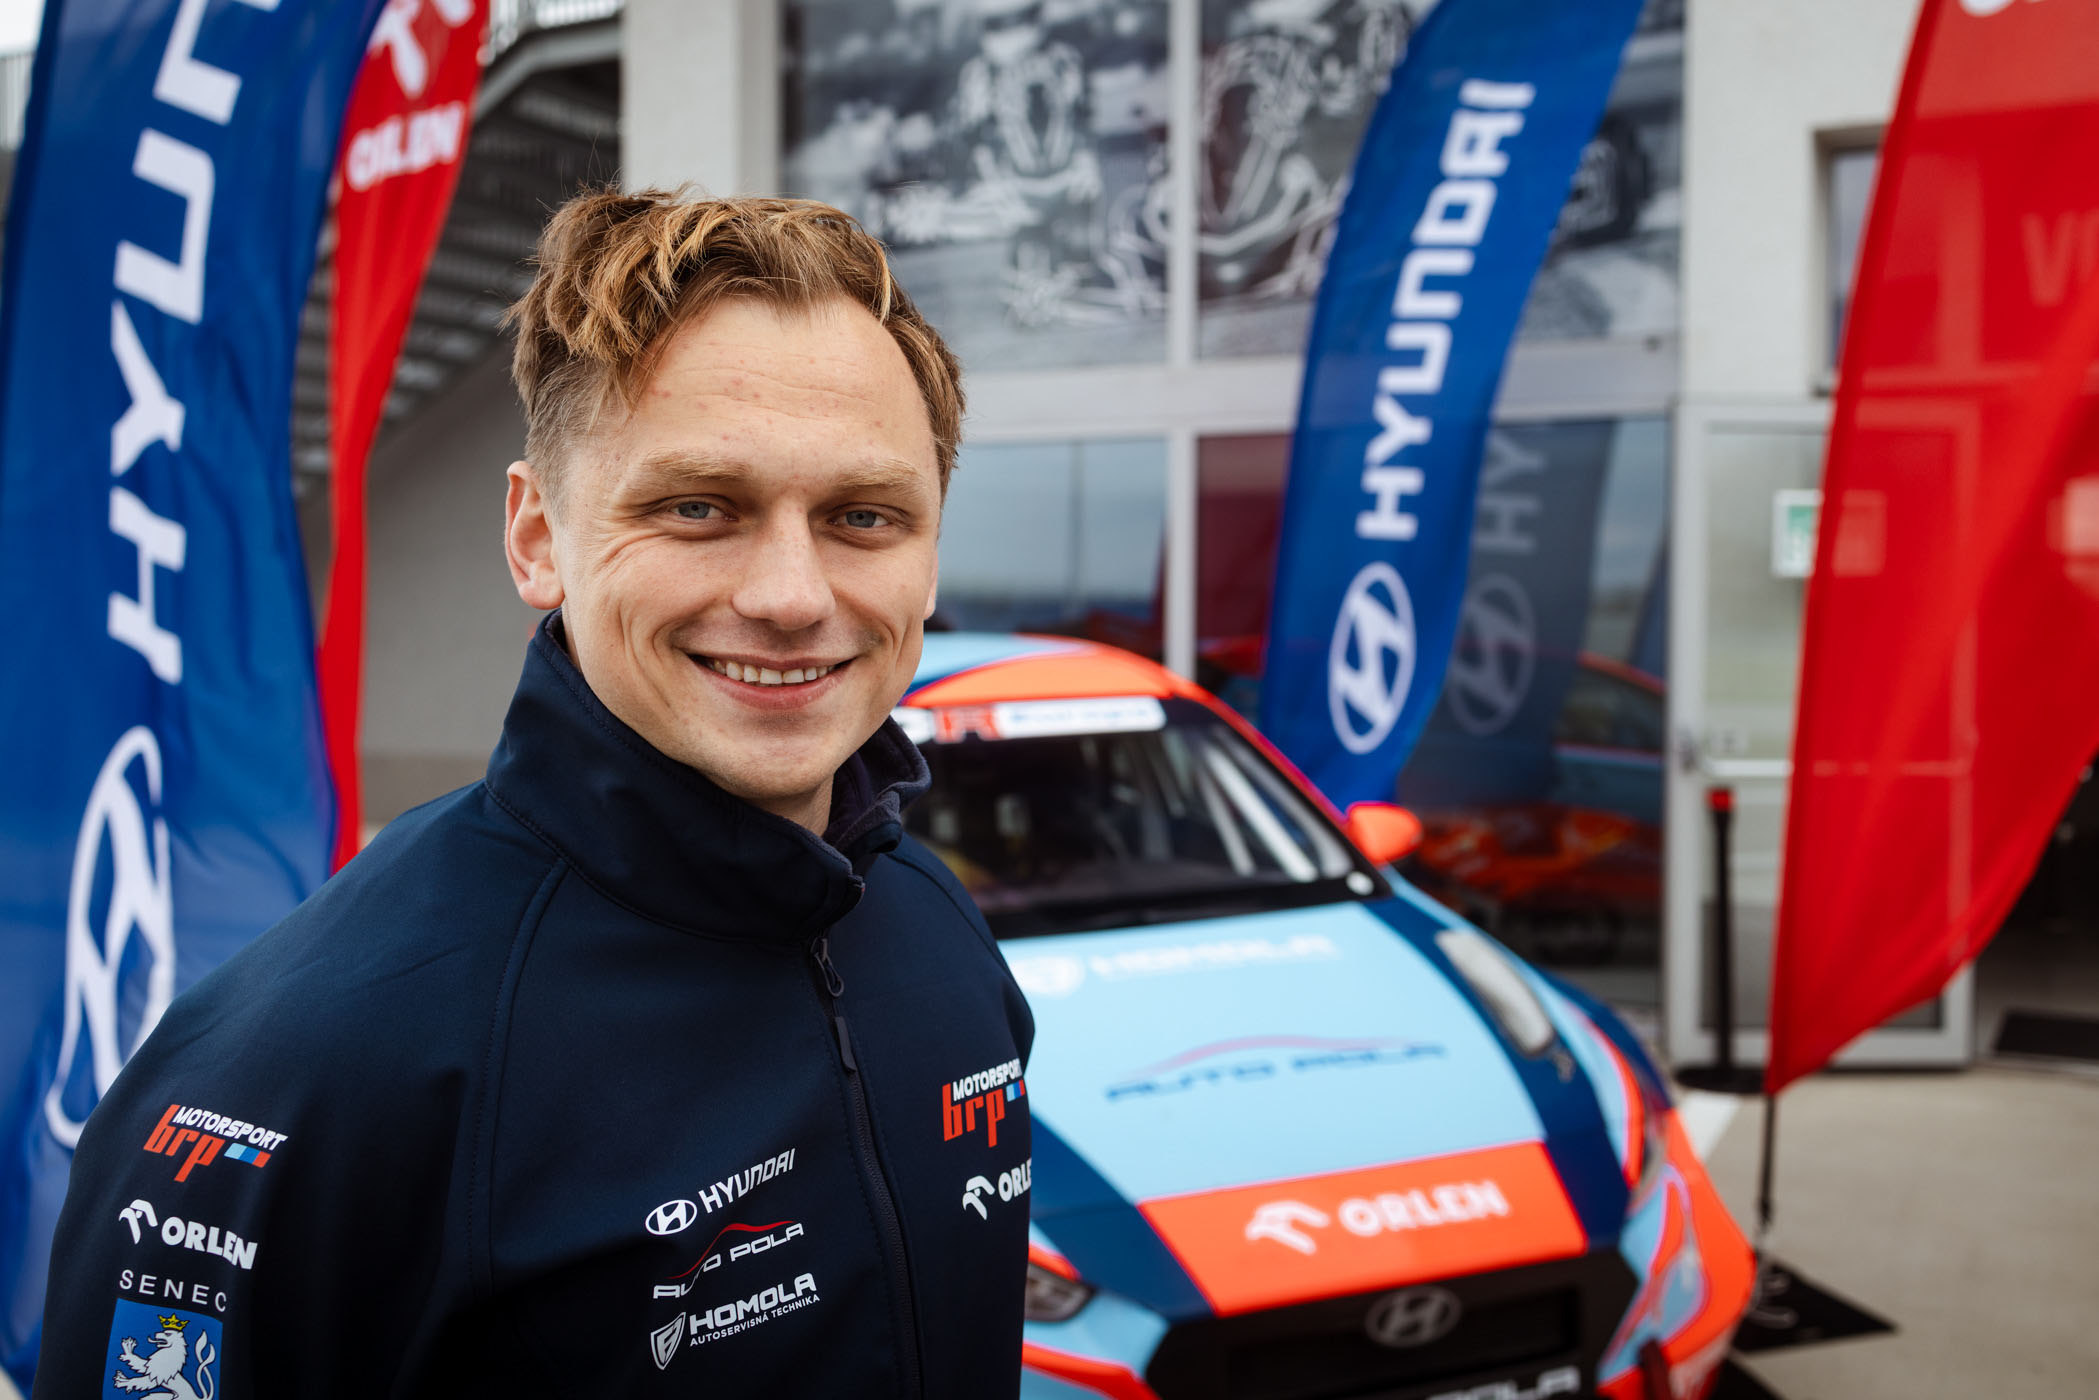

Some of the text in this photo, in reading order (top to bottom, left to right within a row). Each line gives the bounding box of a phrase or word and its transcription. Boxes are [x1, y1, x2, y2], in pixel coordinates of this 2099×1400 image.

[1354, 78, 1537, 542] HYUNDAI
[952, 1058, 1023, 1101] MOTORSPOR
[172, 1106, 289, 1150] MOTORSPORT
[942, 1083, 1006, 1148] brp
[143, 1104, 226, 1183] brp
[698, 1148, 796, 1214] HYUNDAI
[998, 1157, 1032, 1202] ORLE
[1338, 1179, 1512, 1237] ORLEN
[161, 1216, 258, 1270] ORLEN
[730, 1223, 804, 1262] POLA
[119, 1269, 227, 1313] SENEC
[689, 1272, 817, 1336] HOMOLA
[690, 1294, 820, 1347] AUTOSERVISNÁ TECHNIKA
